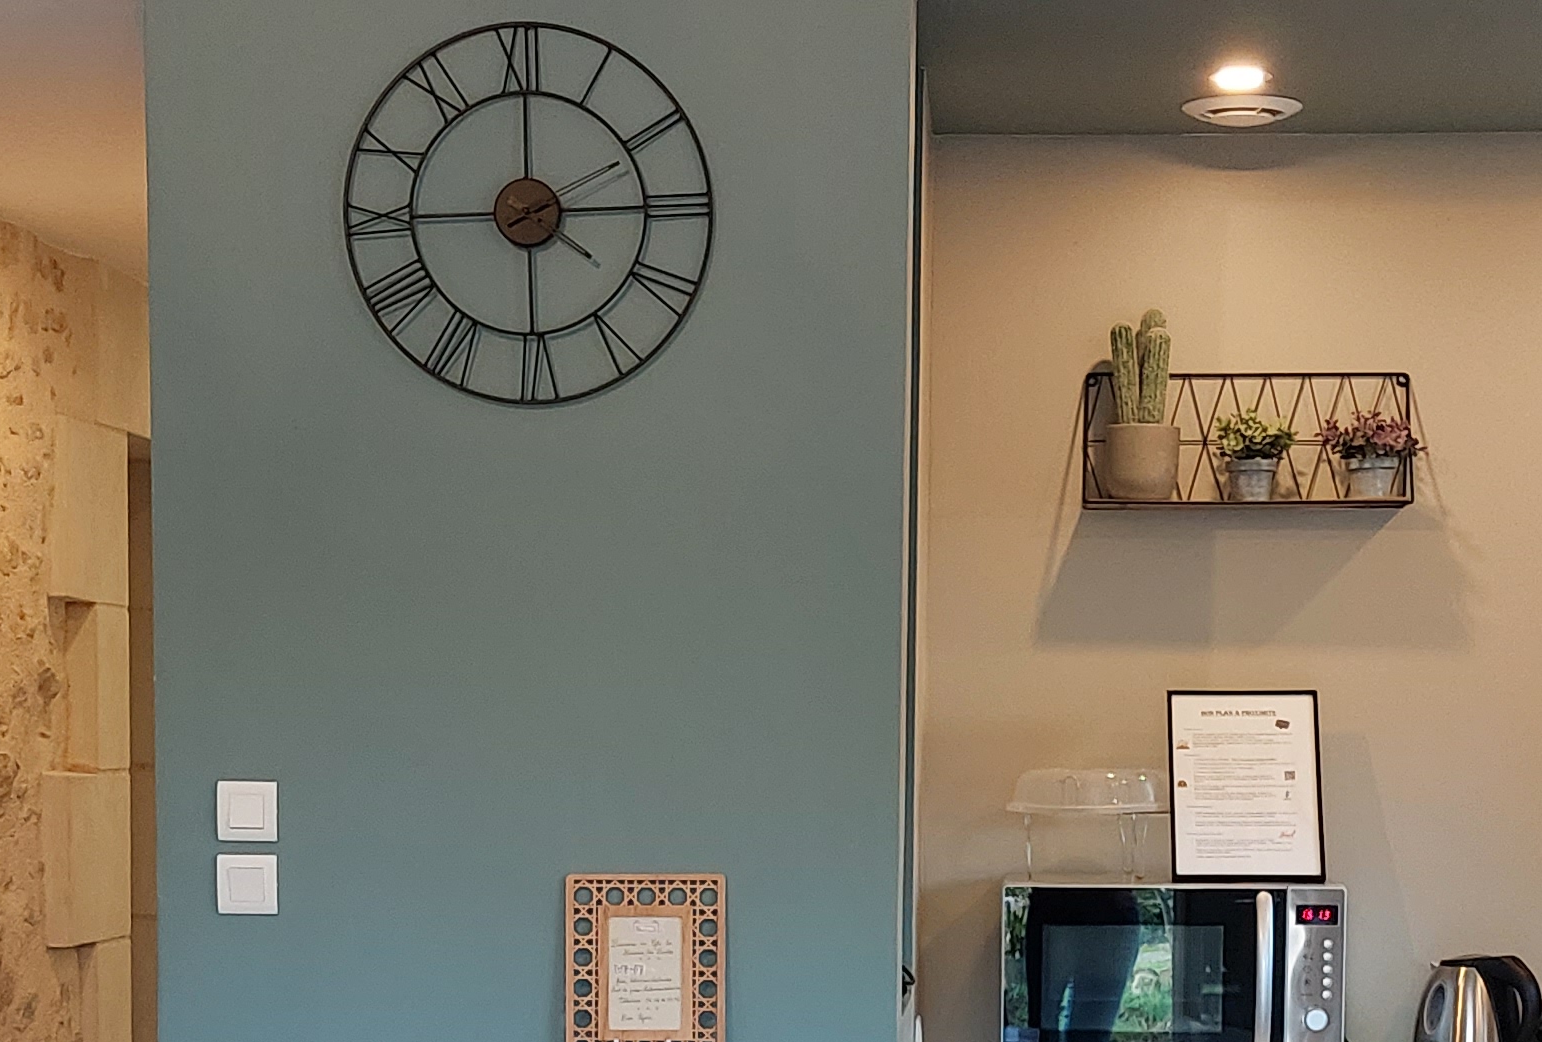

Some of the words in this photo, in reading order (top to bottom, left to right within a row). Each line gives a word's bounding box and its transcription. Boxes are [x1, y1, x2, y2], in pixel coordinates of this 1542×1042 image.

[401, 50, 471, 125] XI
[493, 26, 541, 93] XII
[357, 126, 426, 175] X
[622, 107, 686, 153] II
[347, 202, 413, 237] IX
[643, 190, 711, 219] III
[363, 257, 436, 336] VIII
[422, 308, 479, 389] VII
[519, 333, 561, 403] VI
[591, 312, 644, 378] V
